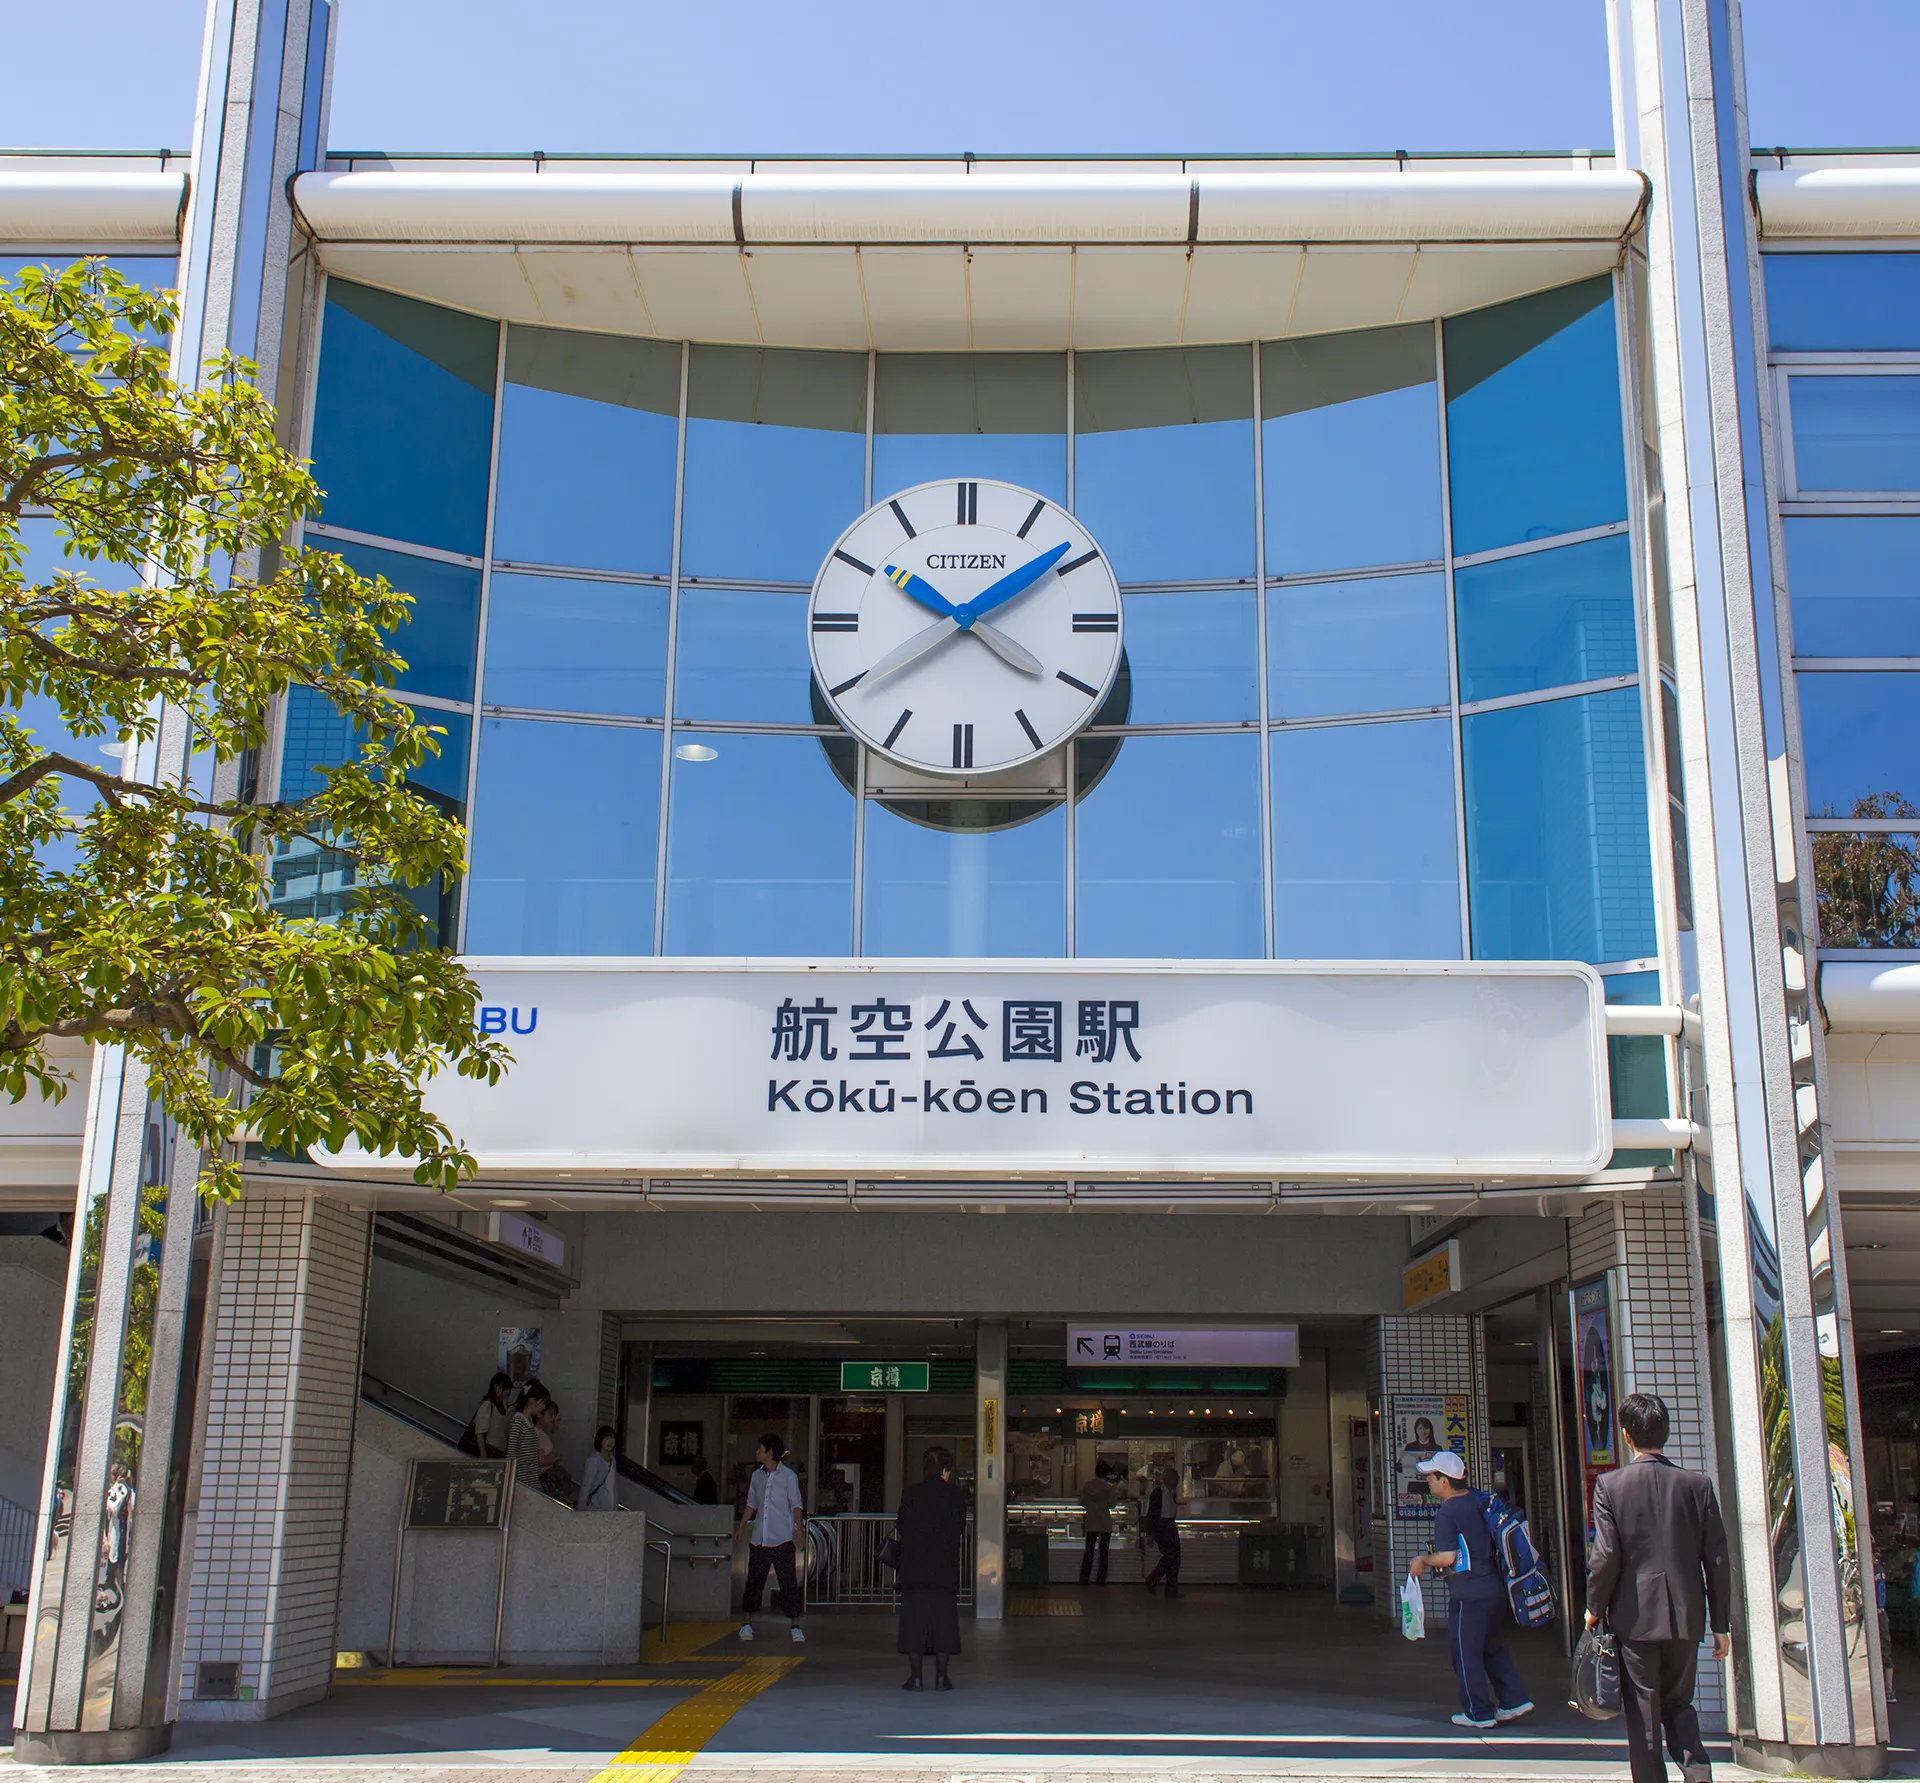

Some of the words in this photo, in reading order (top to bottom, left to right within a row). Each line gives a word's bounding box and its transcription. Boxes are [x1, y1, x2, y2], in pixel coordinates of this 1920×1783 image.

[926, 554, 1006, 569] CITIZEN
[473, 1007, 538, 1035] BU
[770, 998, 1142, 1063] 航空公園駅
[768, 1079, 1047, 1114] Kōkū-kōen
[1070, 1081, 1254, 1115] Station
[1129, 1340, 1175, 1348] 西武線のりば
[870, 1366, 900, 1387] 京樽
